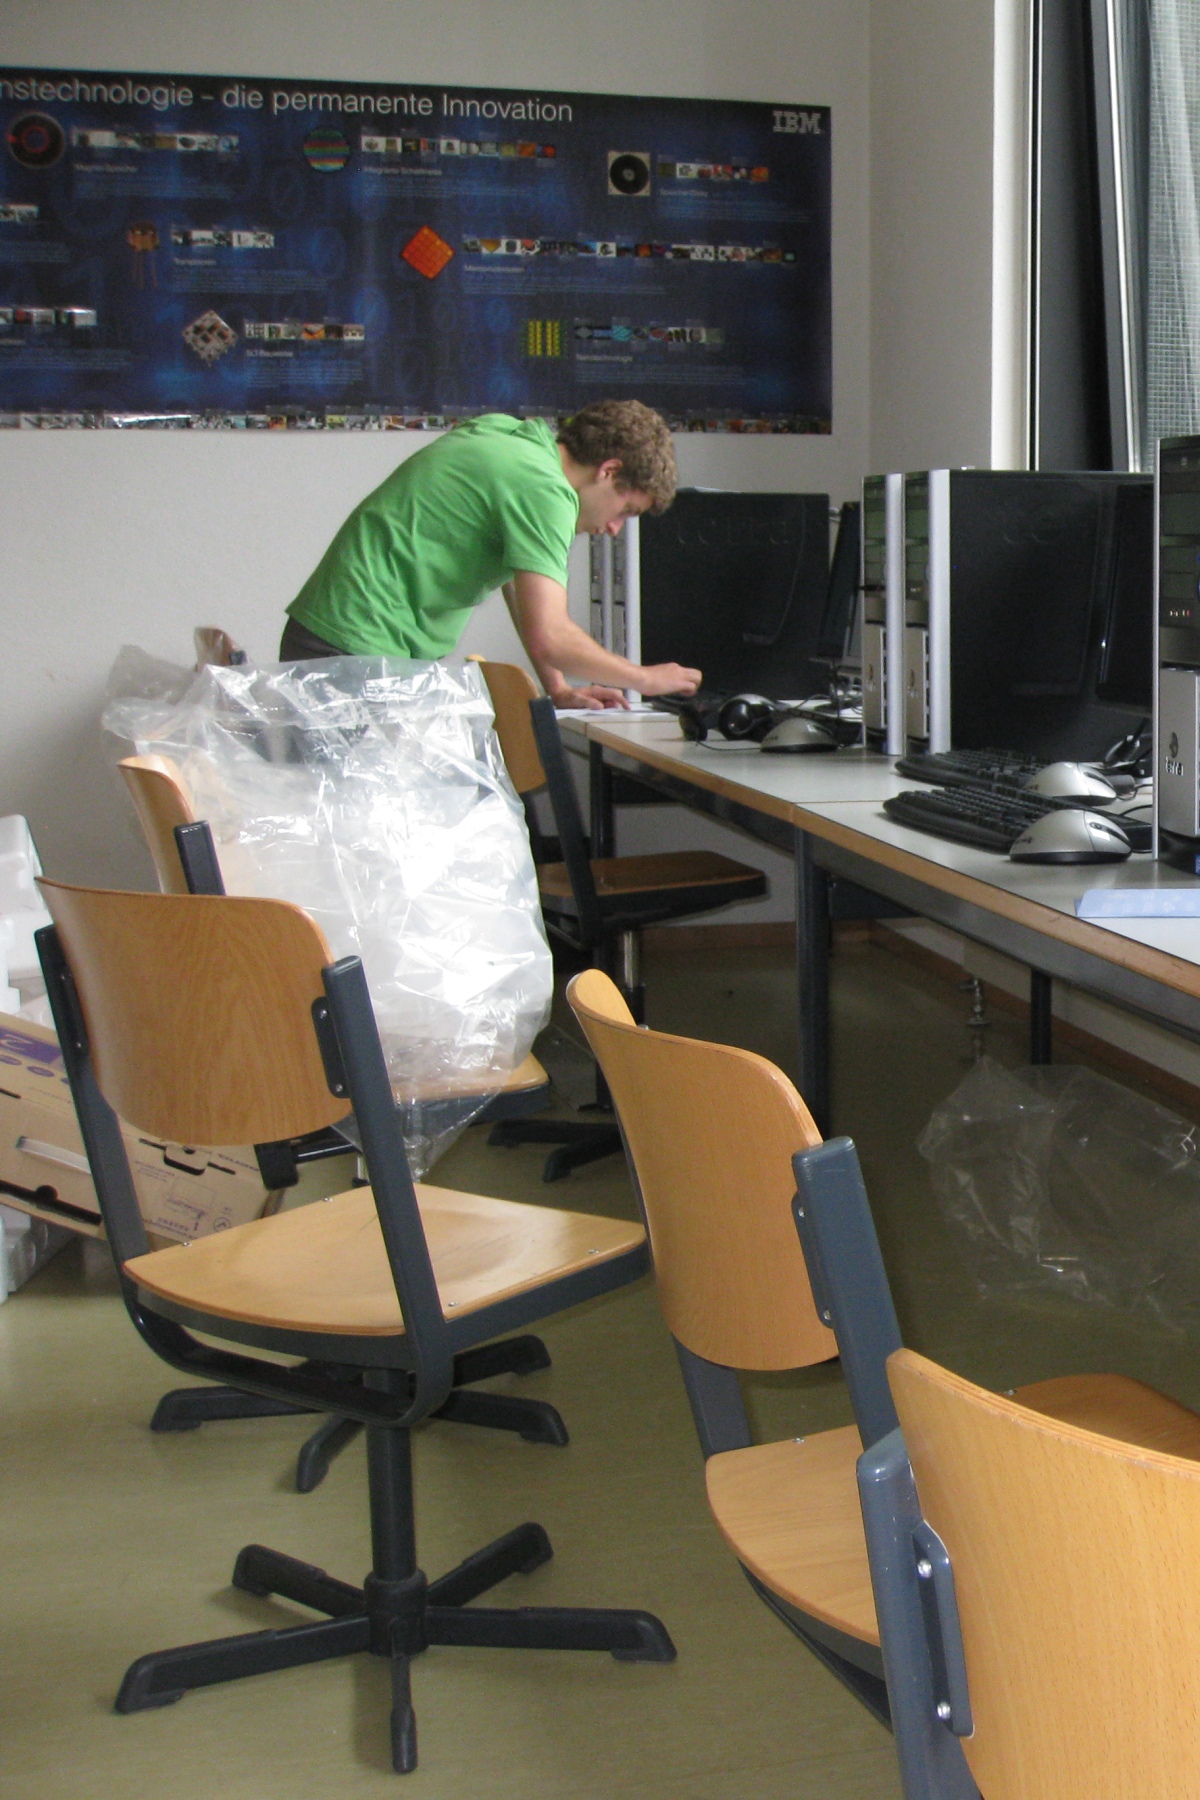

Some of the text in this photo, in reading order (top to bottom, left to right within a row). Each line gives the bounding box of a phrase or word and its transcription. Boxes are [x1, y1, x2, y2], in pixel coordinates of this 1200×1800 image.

[222, 86, 264, 109] die
[272, 90, 433, 116] permanente
[442, 94, 574, 122] Innovation
[772, 110, 822, 135] IBM
